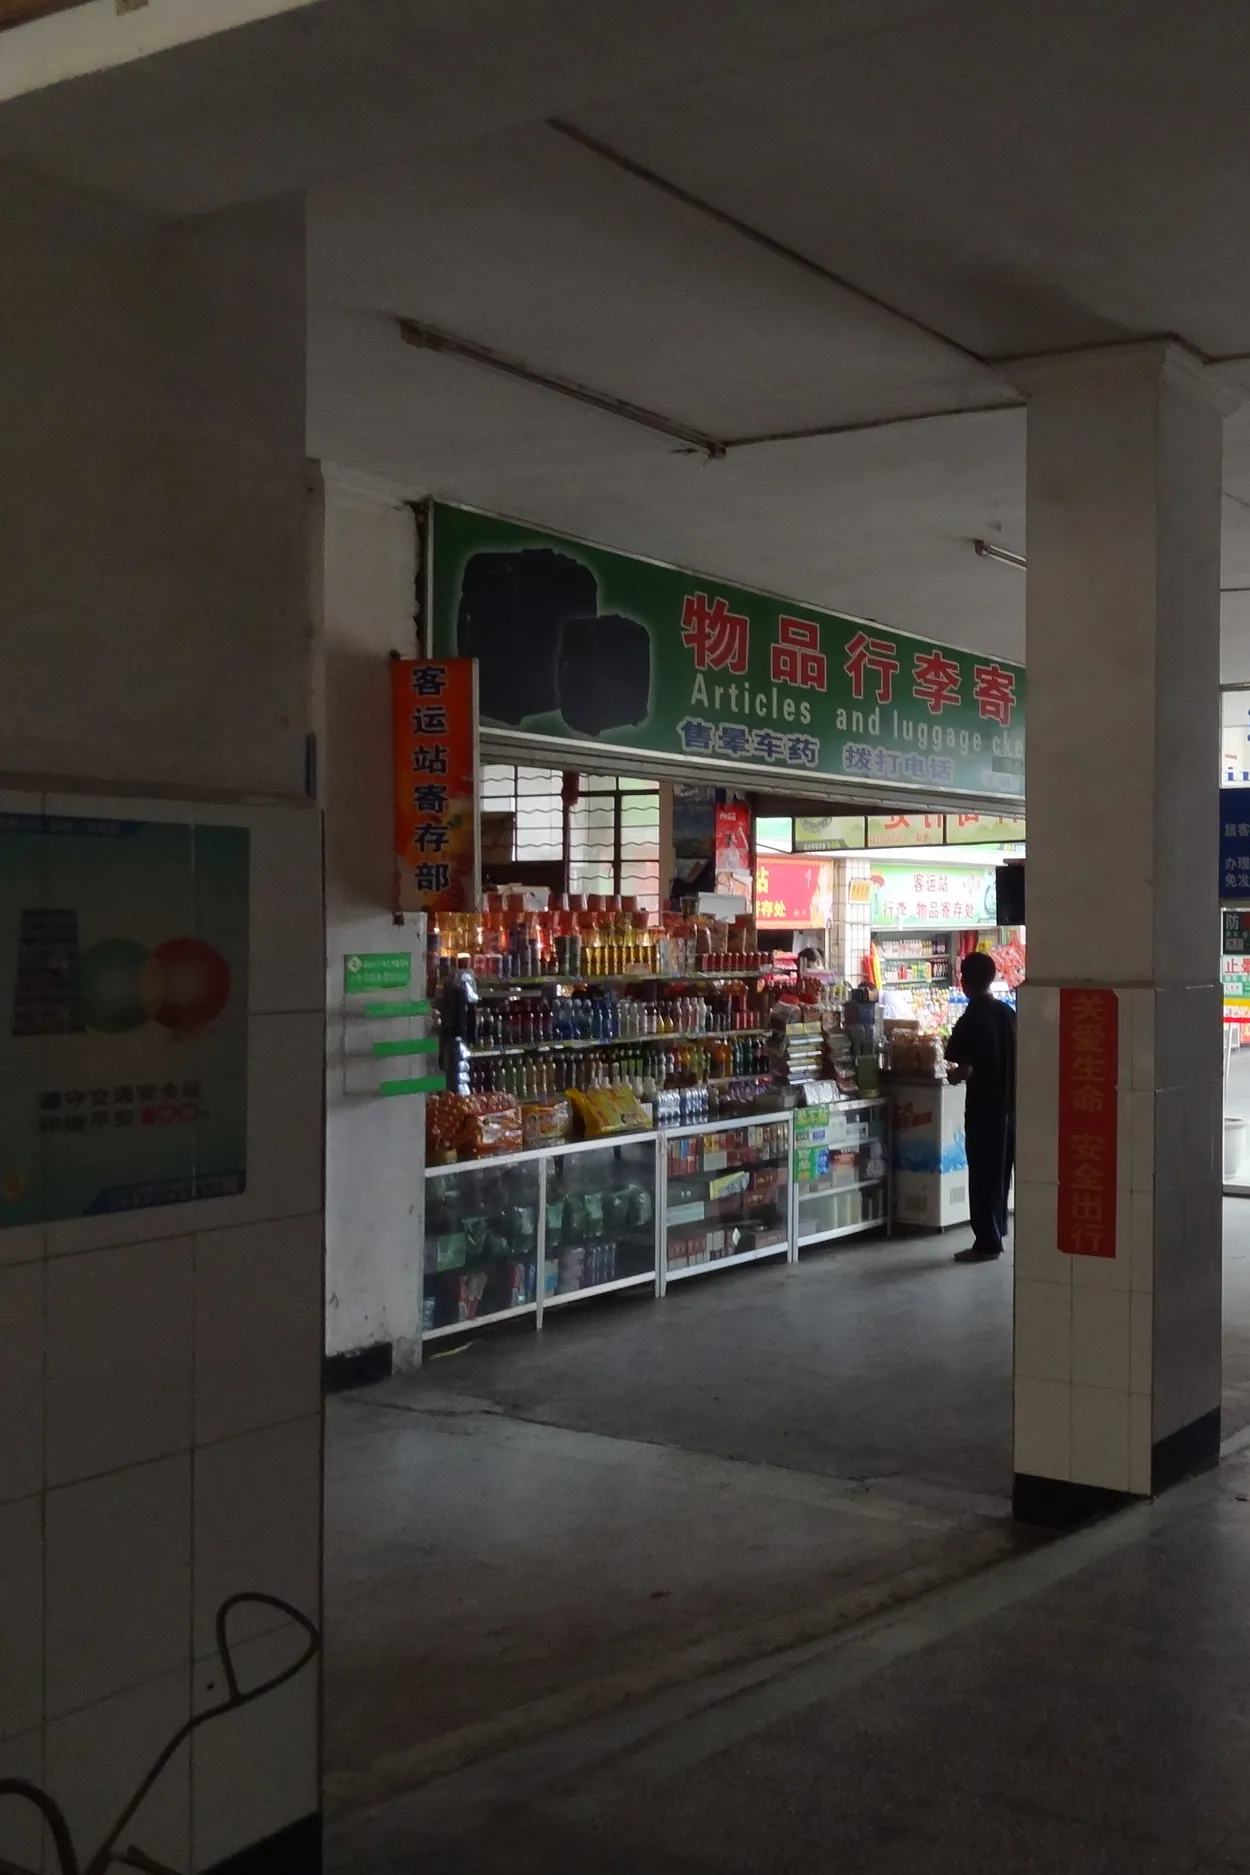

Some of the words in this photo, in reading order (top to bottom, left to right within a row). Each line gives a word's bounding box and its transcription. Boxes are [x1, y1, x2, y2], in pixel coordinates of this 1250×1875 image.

[680, 591, 1016, 727] 物品行李寄
[678, 717, 819, 766] 售晕车药
[843, 743, 953, 781] 拨打电话
[690, 673, 812, 725] Articles
[836, 706, 880, 736] and
[893, 709, 982, 755] luggage
[411, 666, 449, 892] 客运站寄存部
[756, 900, 786, 918] 存处
[913, 873, 949, 892] 客运站
[1070, 994, 1107, 1114] 关爱生命
[1070, 1132, 1104, 1251] 安全出行
